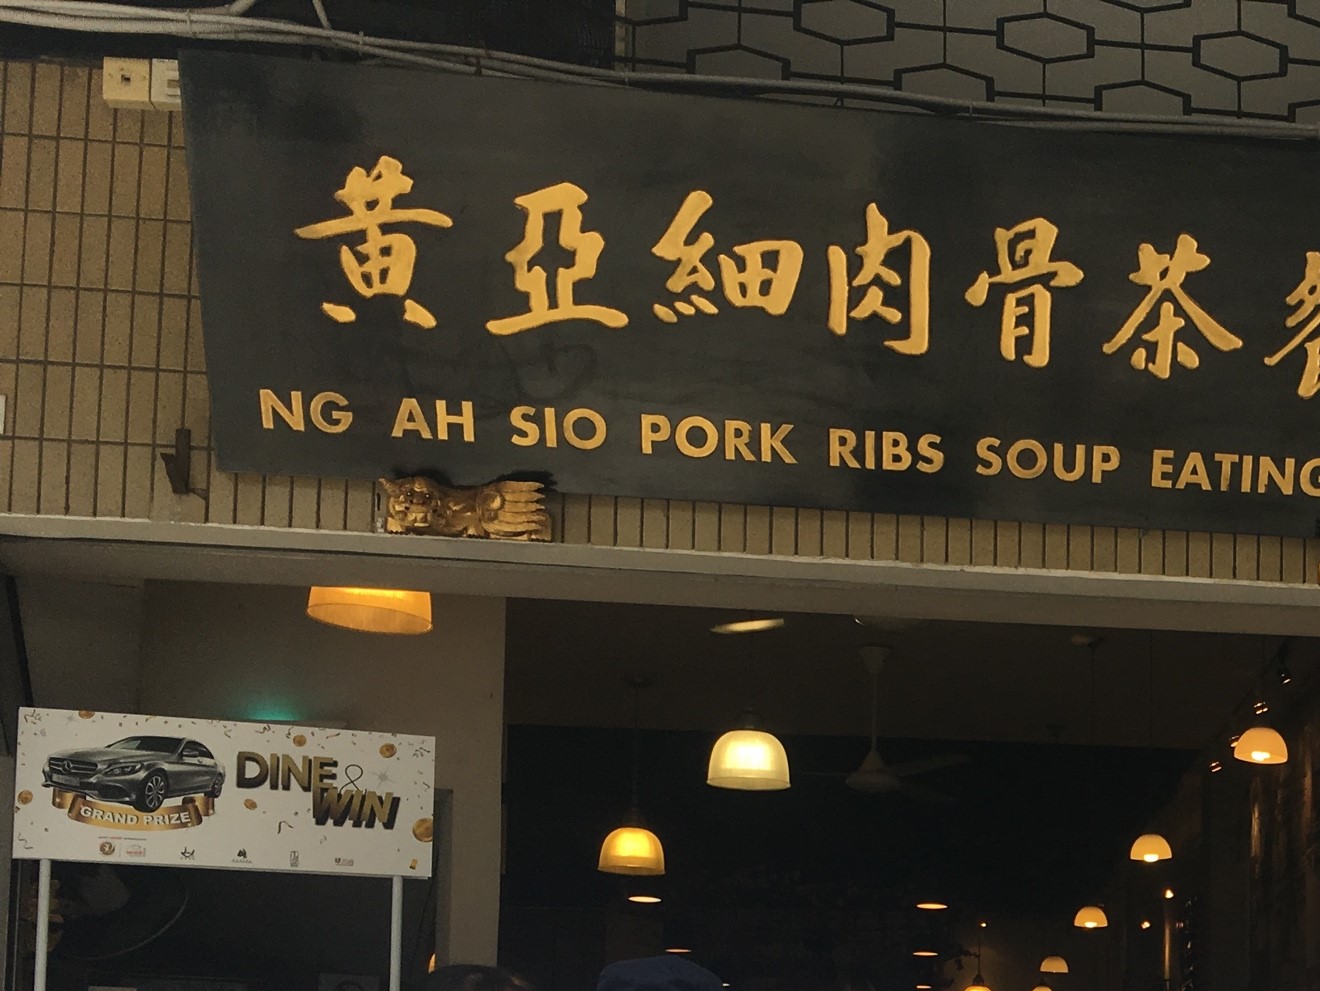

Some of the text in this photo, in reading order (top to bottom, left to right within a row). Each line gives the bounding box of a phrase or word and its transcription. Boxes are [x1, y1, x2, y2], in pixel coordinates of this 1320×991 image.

[259, 388, 353, 434] NG
[391, 397, 476, 443] AH
[511, 406, 608, 451] SIO
[640, 413, 797, 465] PORK
[828, 429, 945, 474] RIBS
[975, 438, 1121, 483] SOUP
[235, 750, 338, 793] DINE
[80, 806, 190, 826] GRAND PRIZE
[311, 787, 401, 830] WIN
